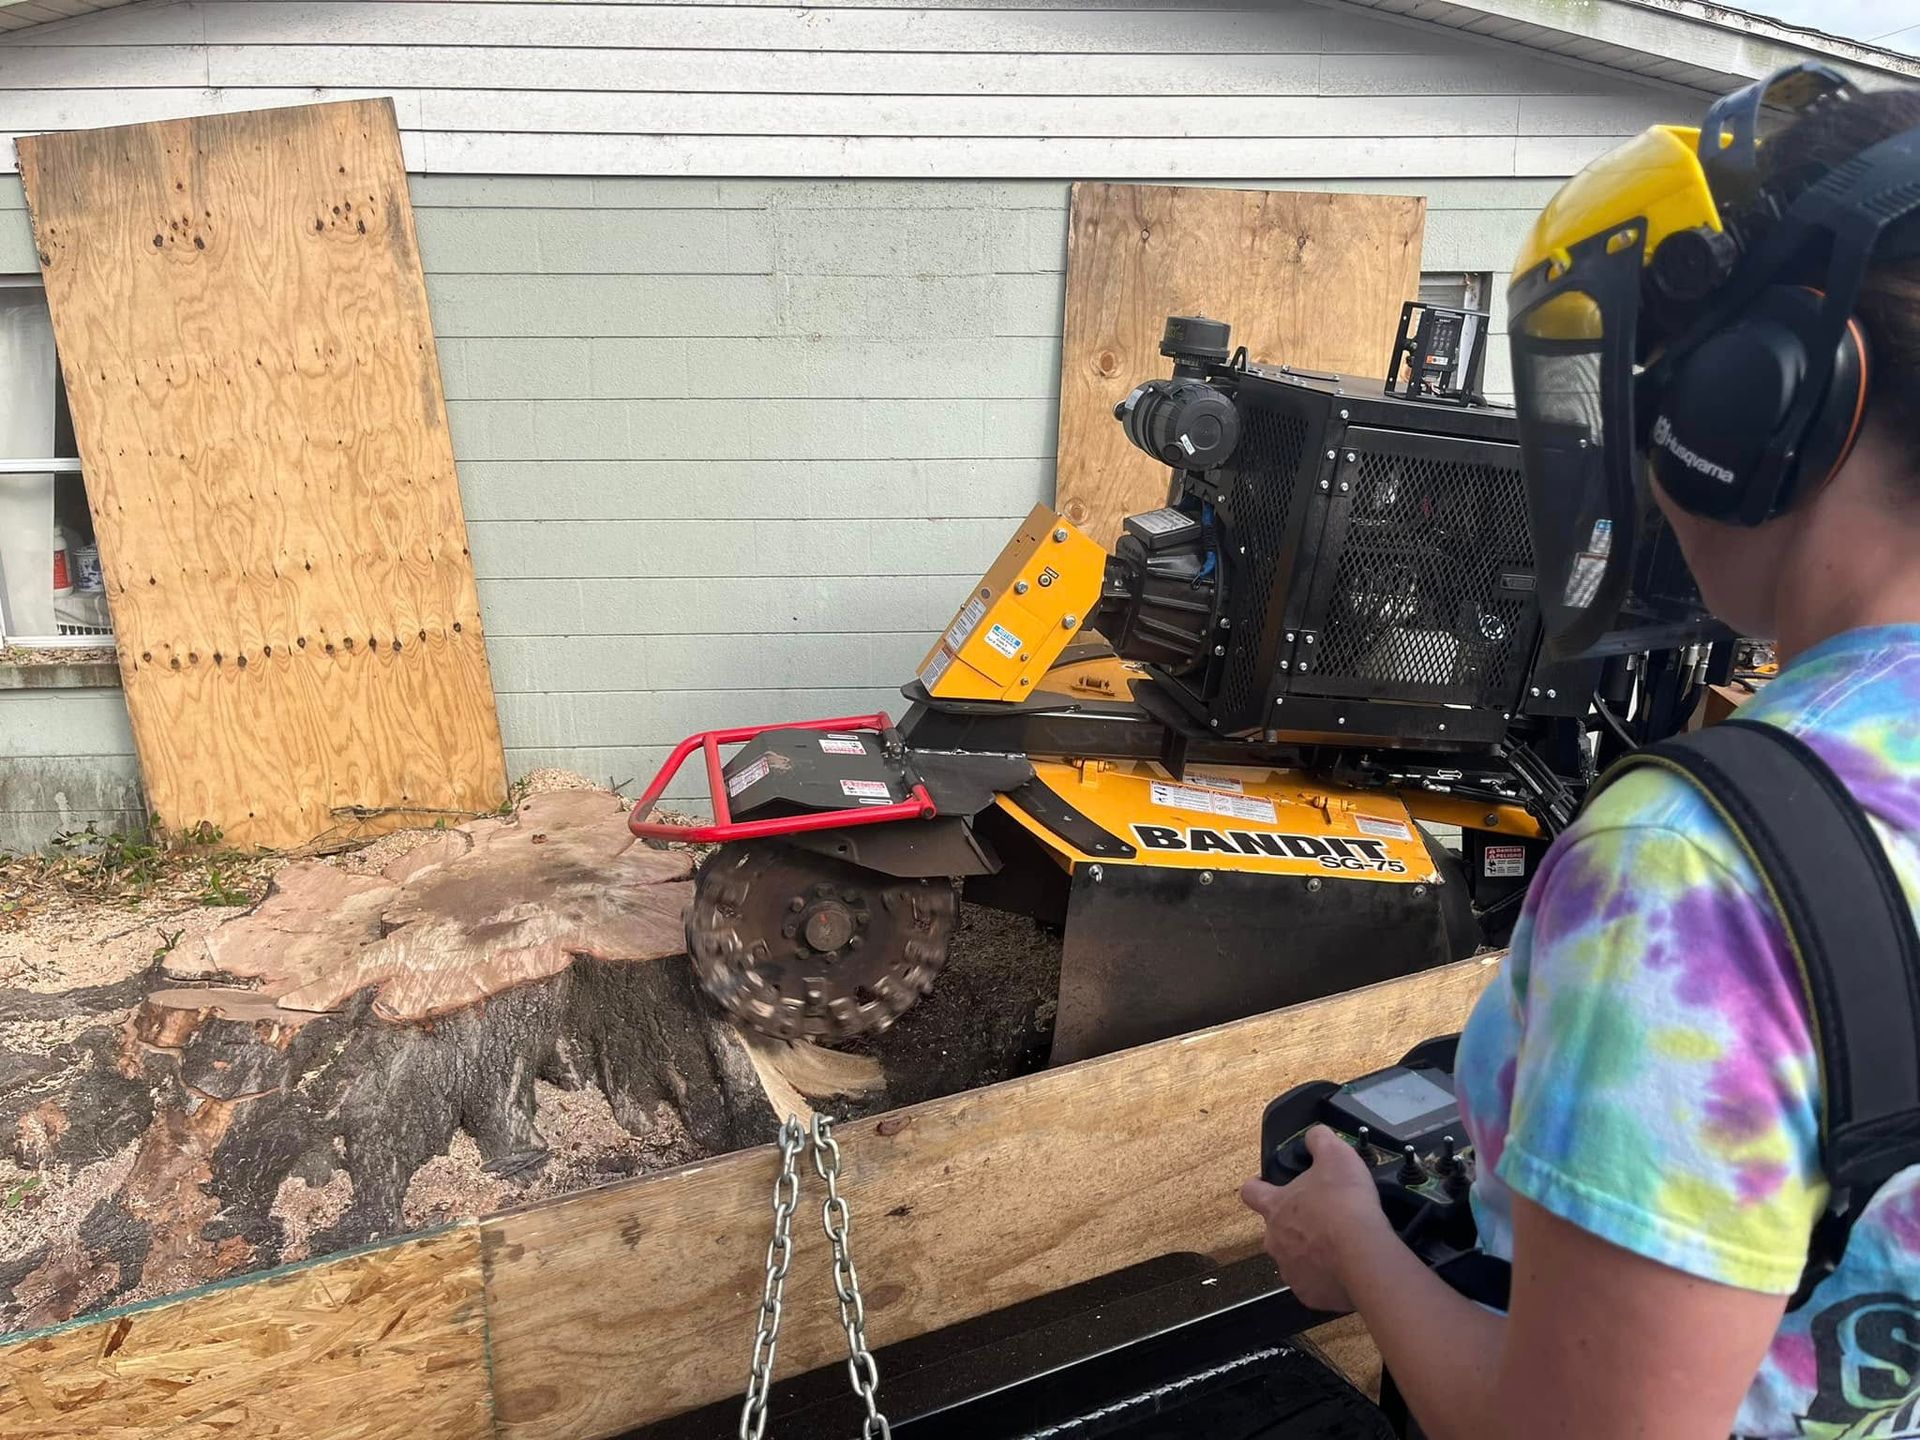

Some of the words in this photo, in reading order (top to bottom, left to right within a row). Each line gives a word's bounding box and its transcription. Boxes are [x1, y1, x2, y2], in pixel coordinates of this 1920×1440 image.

[1664, 433, 1734, 483] Husqvarna
[1132, 824, 1387, 860] BANDIT
[1319, 856, 1406, 873] SG-75
